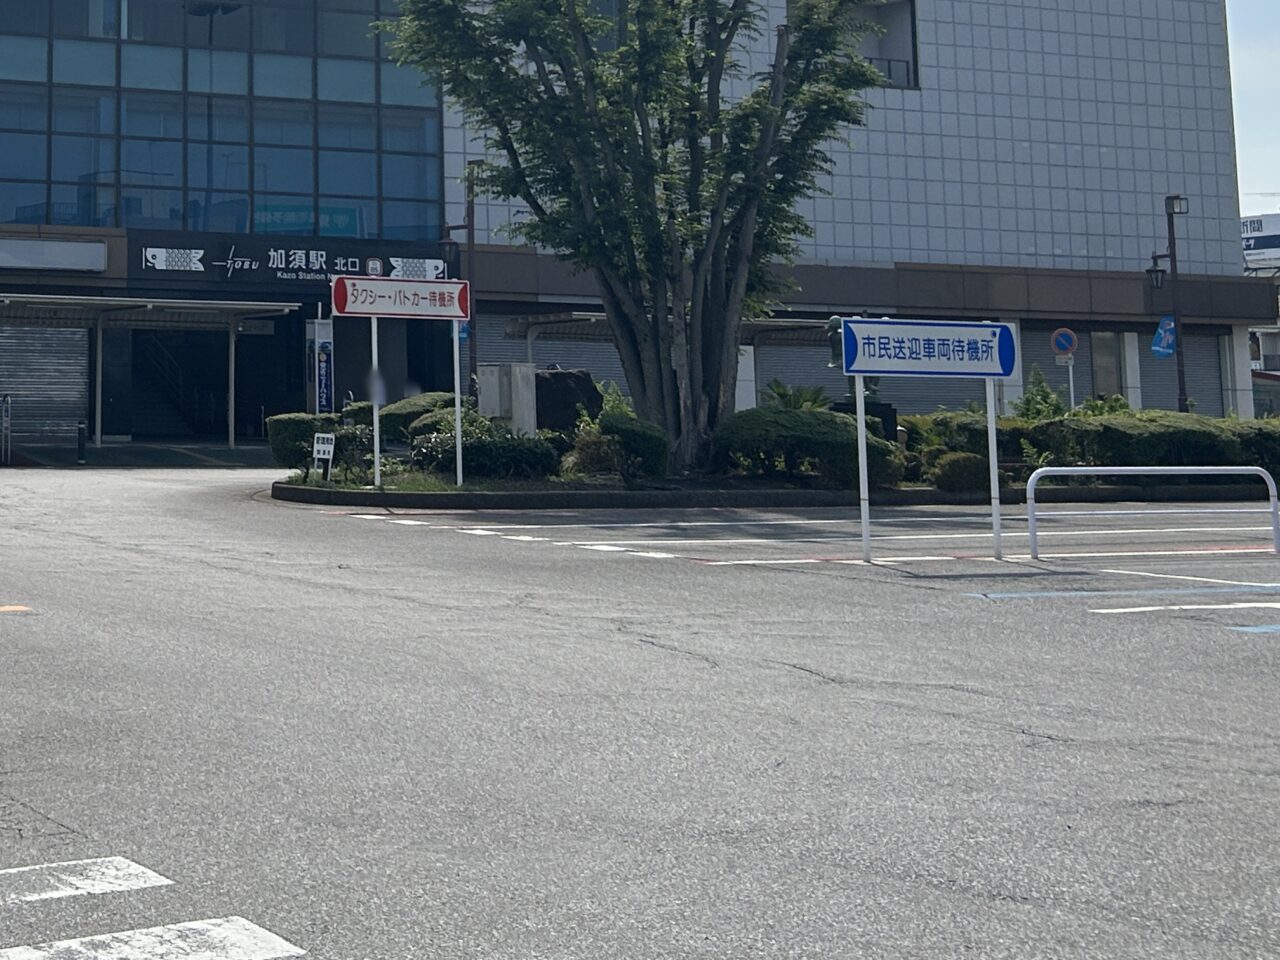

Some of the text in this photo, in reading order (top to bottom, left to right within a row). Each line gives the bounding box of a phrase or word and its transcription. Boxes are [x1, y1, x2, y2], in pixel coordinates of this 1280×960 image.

[268, 248, 327, 271] 加須駅
[334, 257, 360, 272] 北口
[276, 271, 297, 279] Kazo
[298, 271, 326, 280] Station
[862, 335, 995, 362] 市民送迎車両待機所
